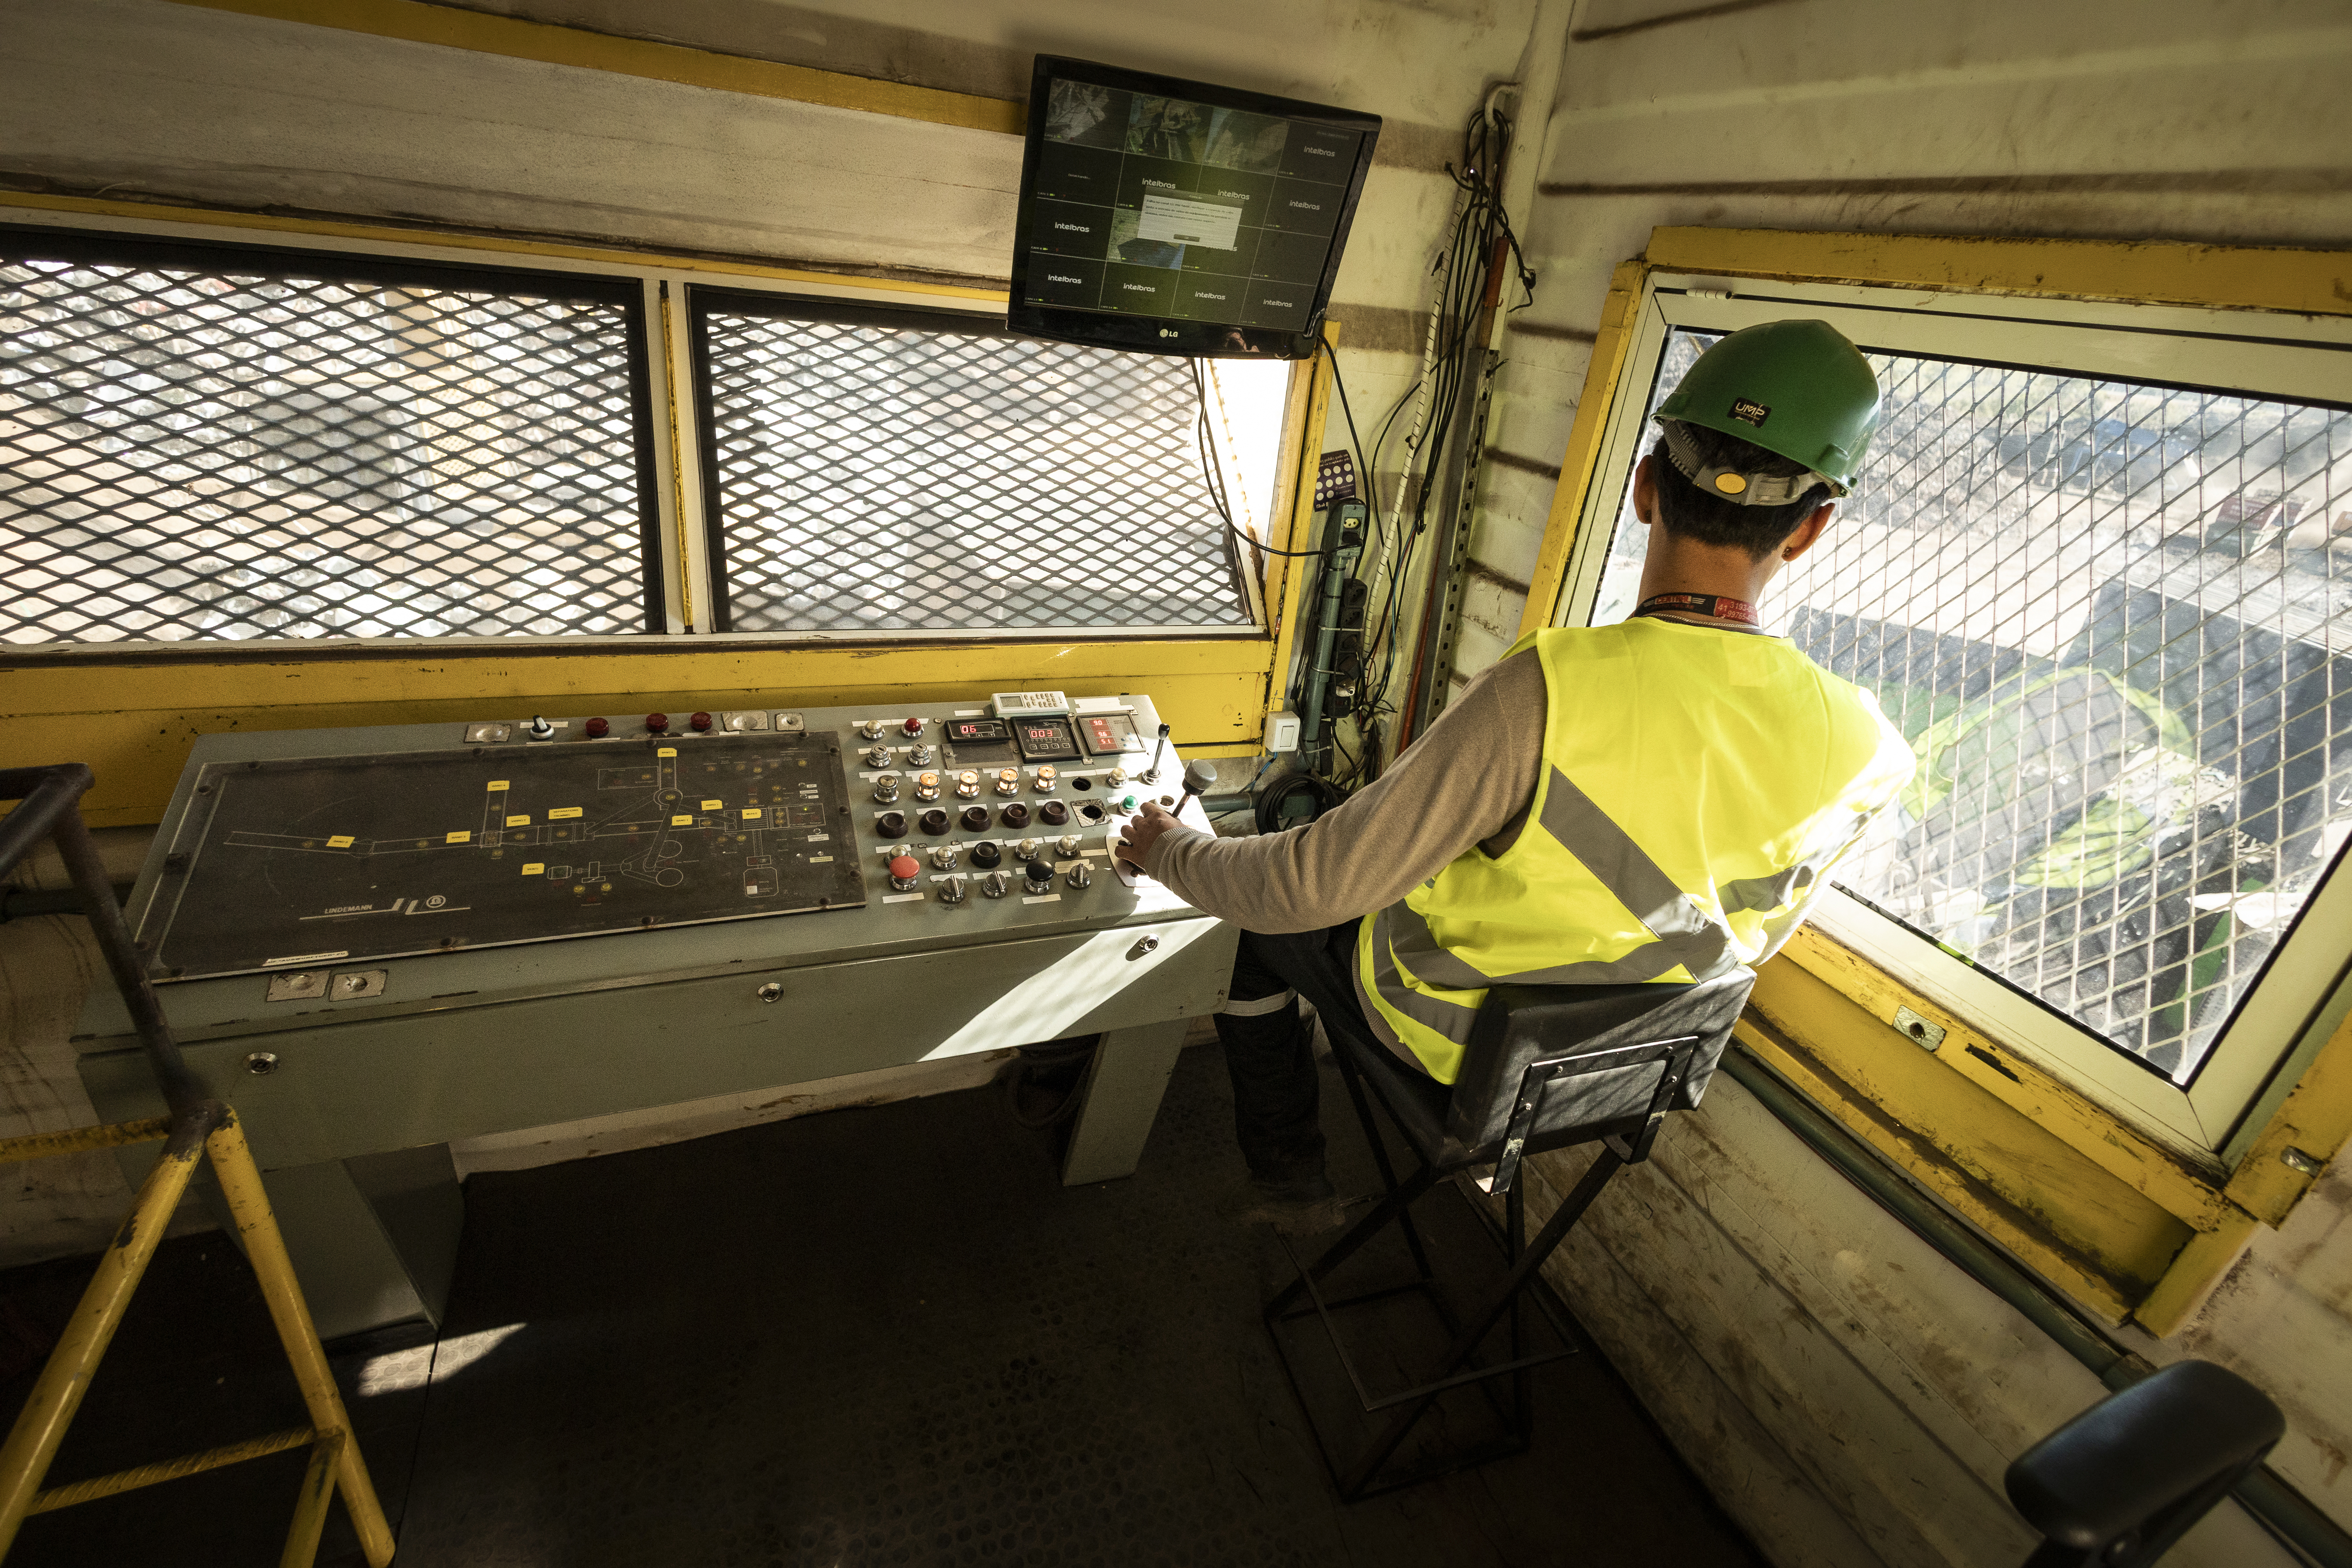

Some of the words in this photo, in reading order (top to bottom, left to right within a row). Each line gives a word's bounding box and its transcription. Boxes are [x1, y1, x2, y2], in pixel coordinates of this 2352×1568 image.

[1303, 146, 1335, 157] intelbras
[1142, 178, 1176, 189] intelbras
[1217, 190, 1250, 200] intelbras
[1289, 199, 1320, 210] intelbras
[1055, 222, 1089, 232] intelbras
[1048, 274, 1081, 284] intelbras
[1123, 283, 1155, 292] intelbras
[1195, 291, 1226, 300] intelbras
[1263, 299, 1292, 308] intelbras
[1735, 402, 1765, 416] UMP
[325, 904, 372, 914] LINDEMANN
